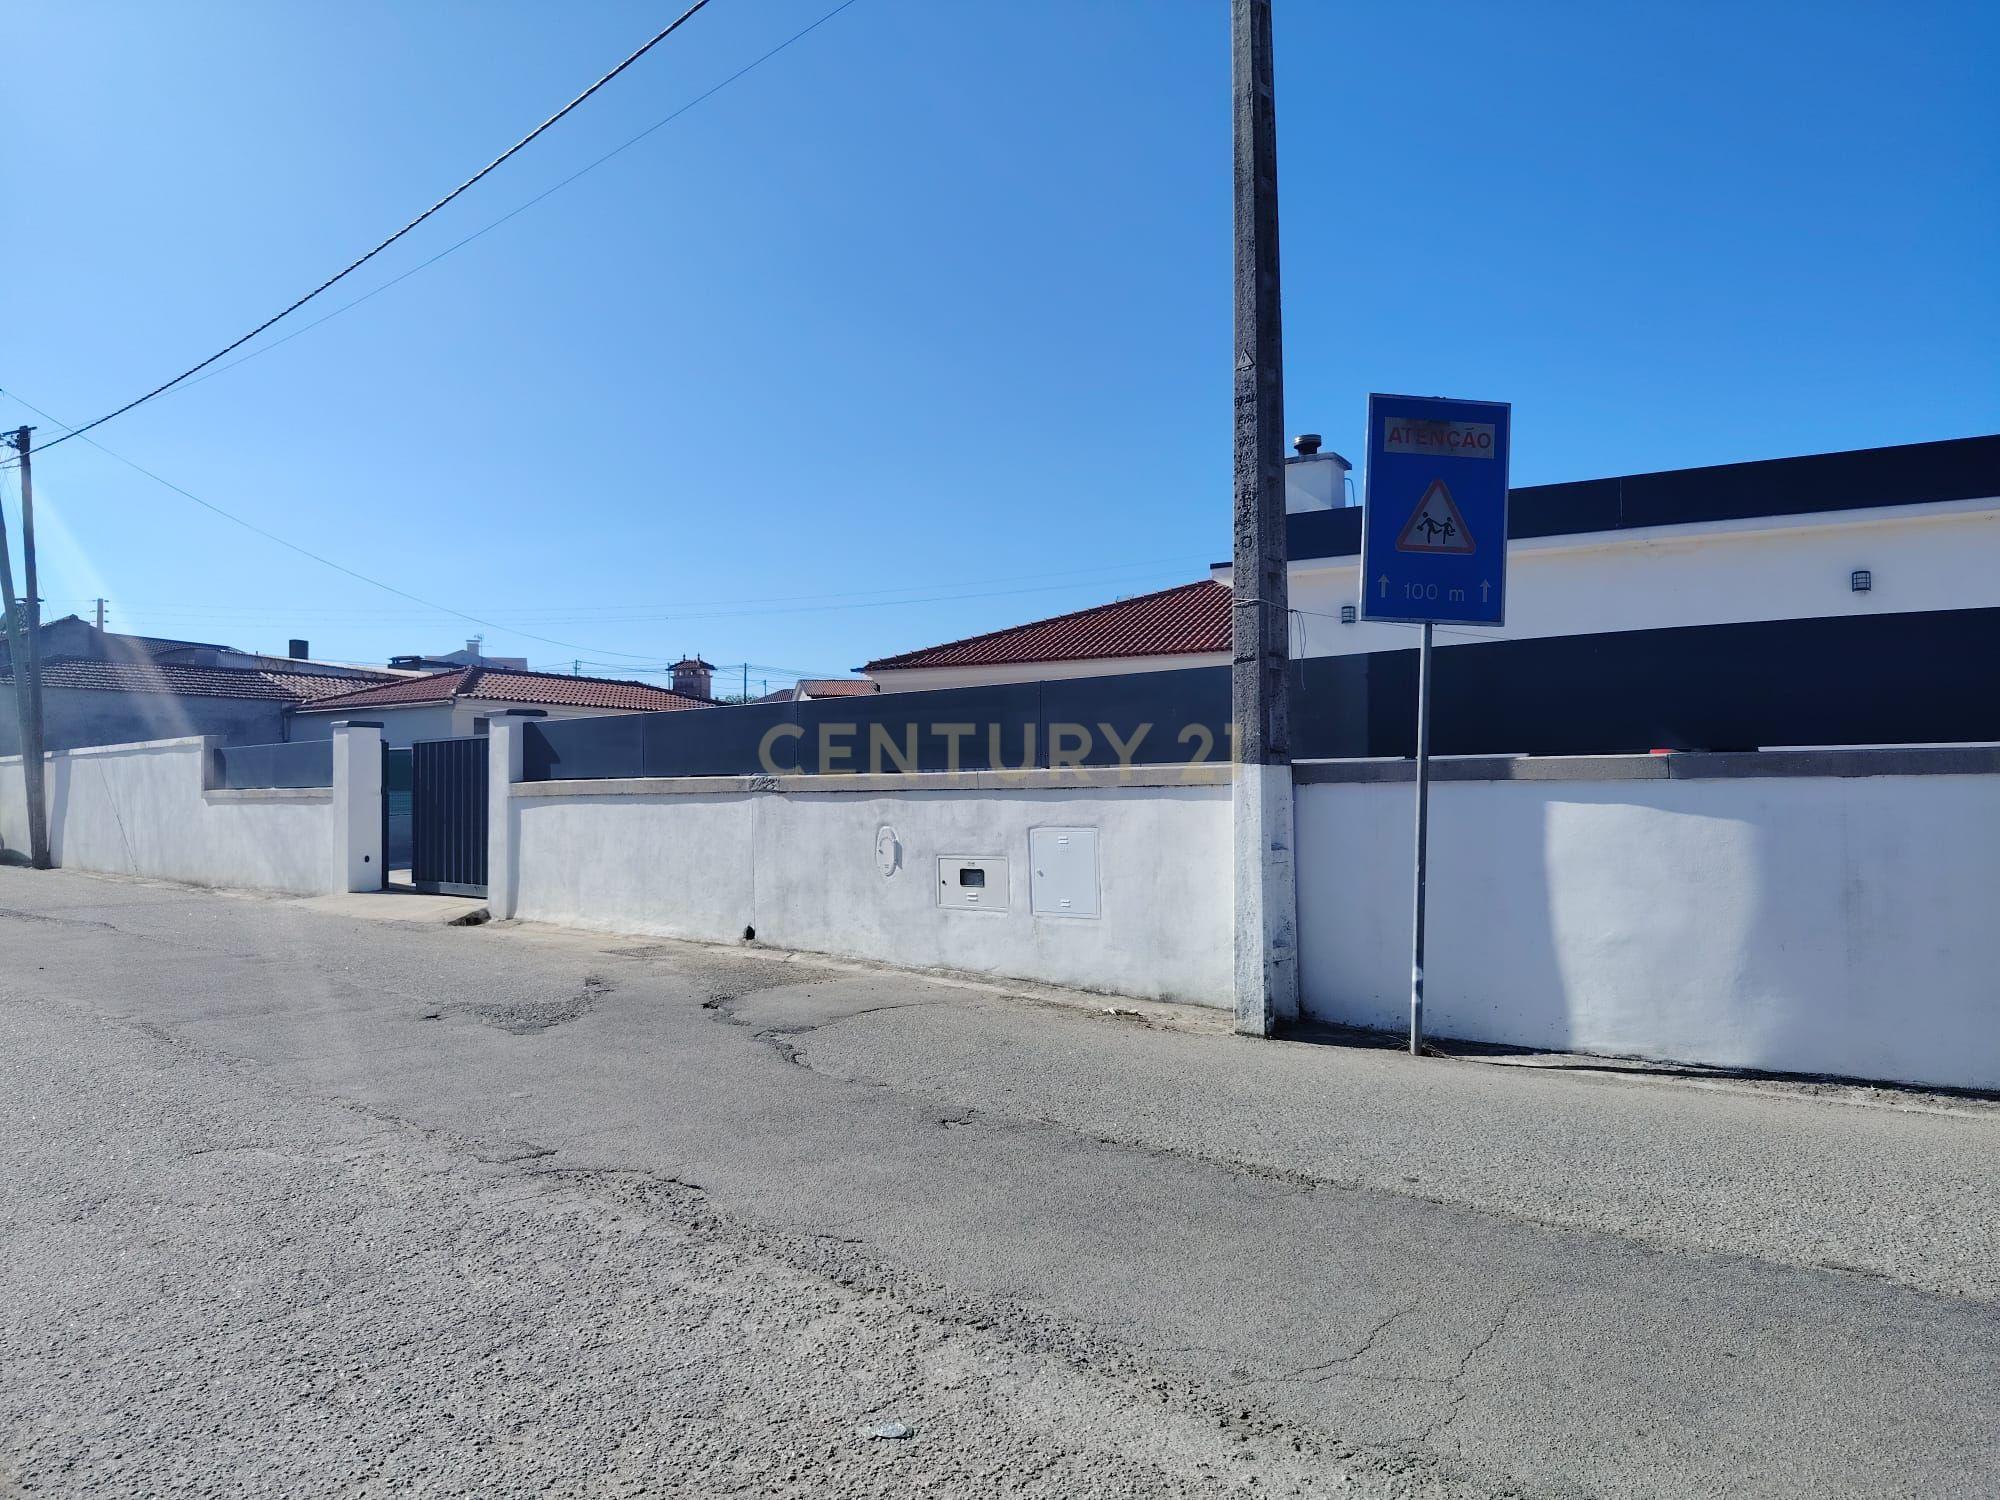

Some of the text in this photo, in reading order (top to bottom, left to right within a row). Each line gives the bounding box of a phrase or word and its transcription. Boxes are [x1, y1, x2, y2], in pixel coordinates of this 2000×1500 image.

[1387, 426, 1492, 451] ATENÇÃO
[1403, 583, 1465, 602] 100 m
